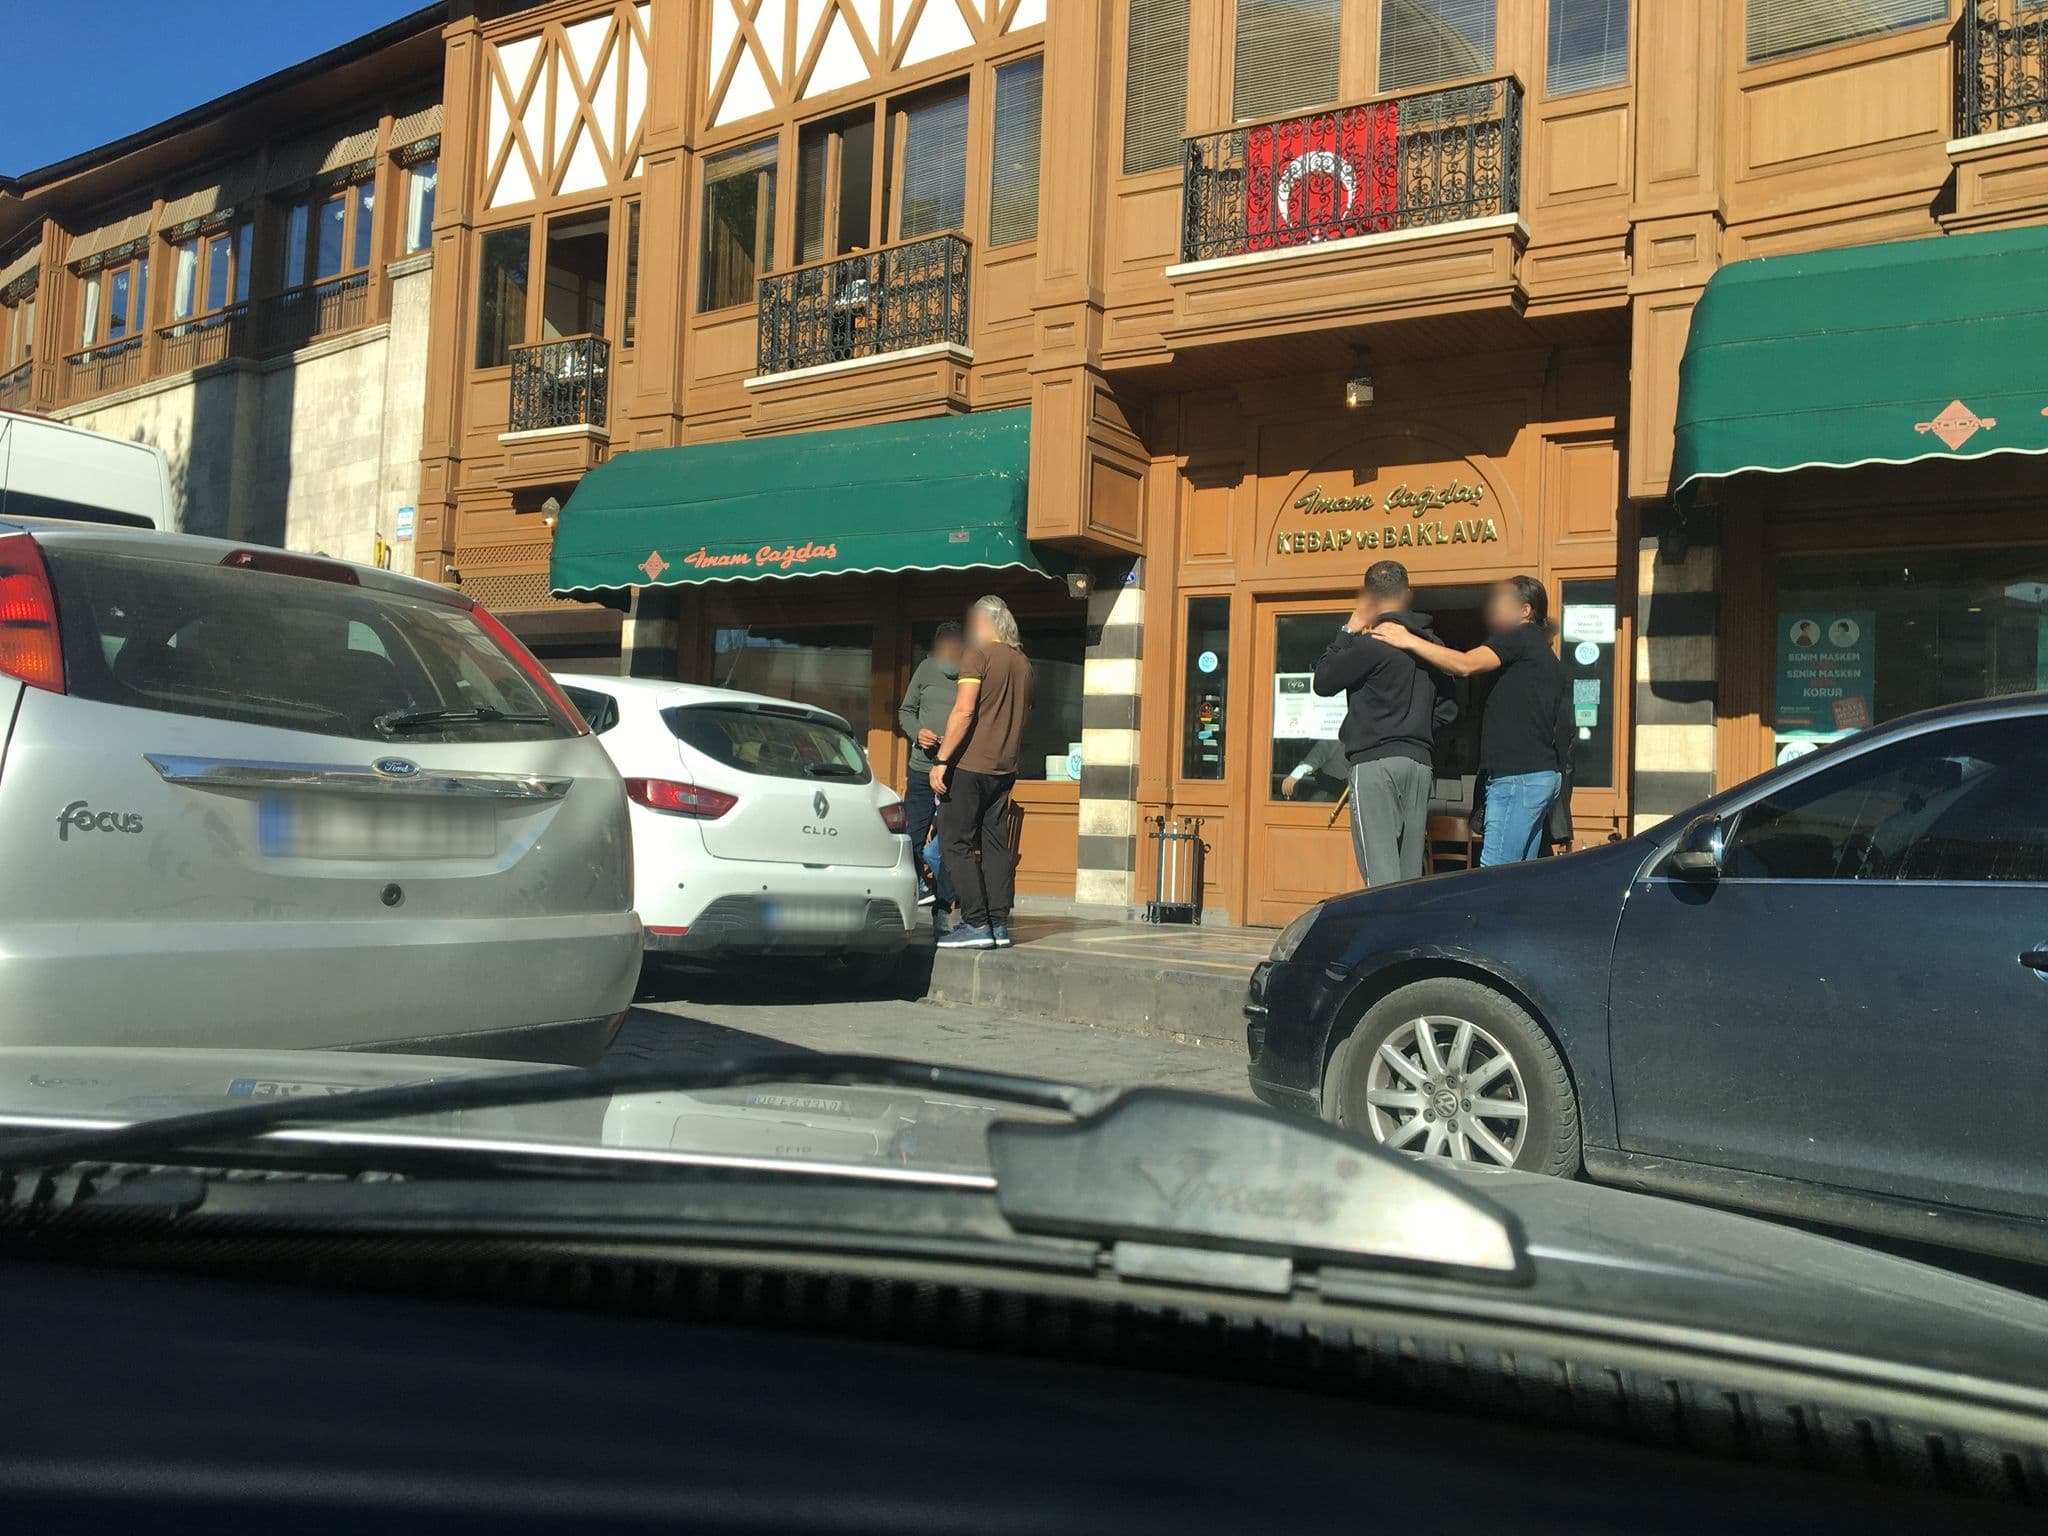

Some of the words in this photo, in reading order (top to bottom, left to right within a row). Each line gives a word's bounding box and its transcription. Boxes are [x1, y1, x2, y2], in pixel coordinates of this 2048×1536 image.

[1294, 484, 1375, 515] İmam
[1383, 479, 1484, 518] Çağdaş
[1276, 528, 1352, 555] KEBAP
[1355, 529, 1380, 550] ve
[1383, 518, 1498, 549] BAKLAVA
[683, 546, 752, 569] İmam
[755, 539, 838, 569] Çağdaş
[1803, 687, 1843, 697] KORUR
[384, 760, 411, 773] Ford
[802, 825, 838, 837] CLIO
